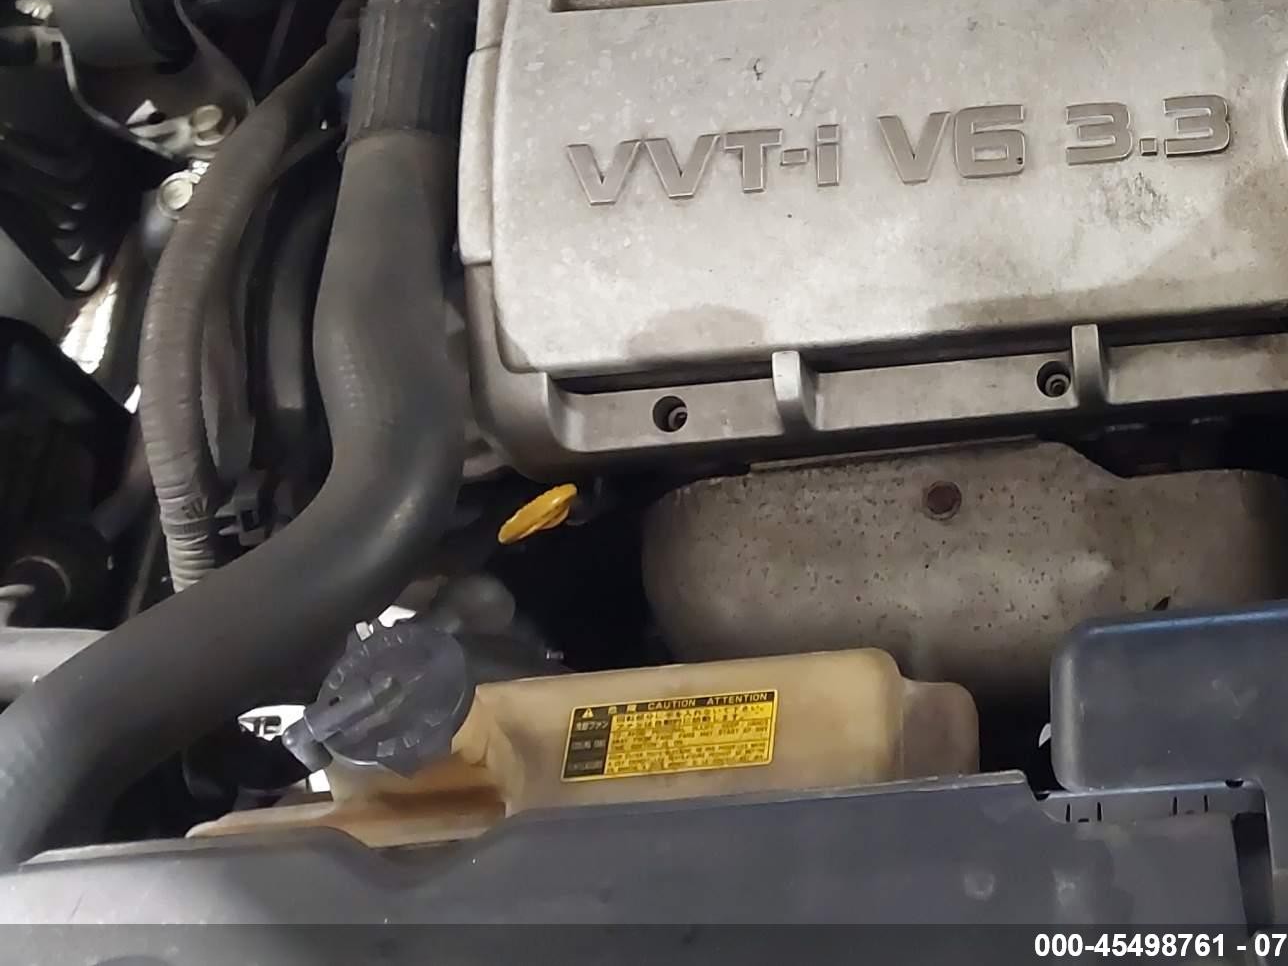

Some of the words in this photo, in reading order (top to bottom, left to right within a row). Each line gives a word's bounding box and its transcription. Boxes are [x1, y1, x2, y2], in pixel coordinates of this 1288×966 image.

[567, 123, 841, 206] VVT-i
[876, 104, 1027, 185] V6
[1066, 95, 1231, 166] 3.3
[647, 698, 696, 711] CAUTION
[706, 692, 768, 706] ATTENTION
